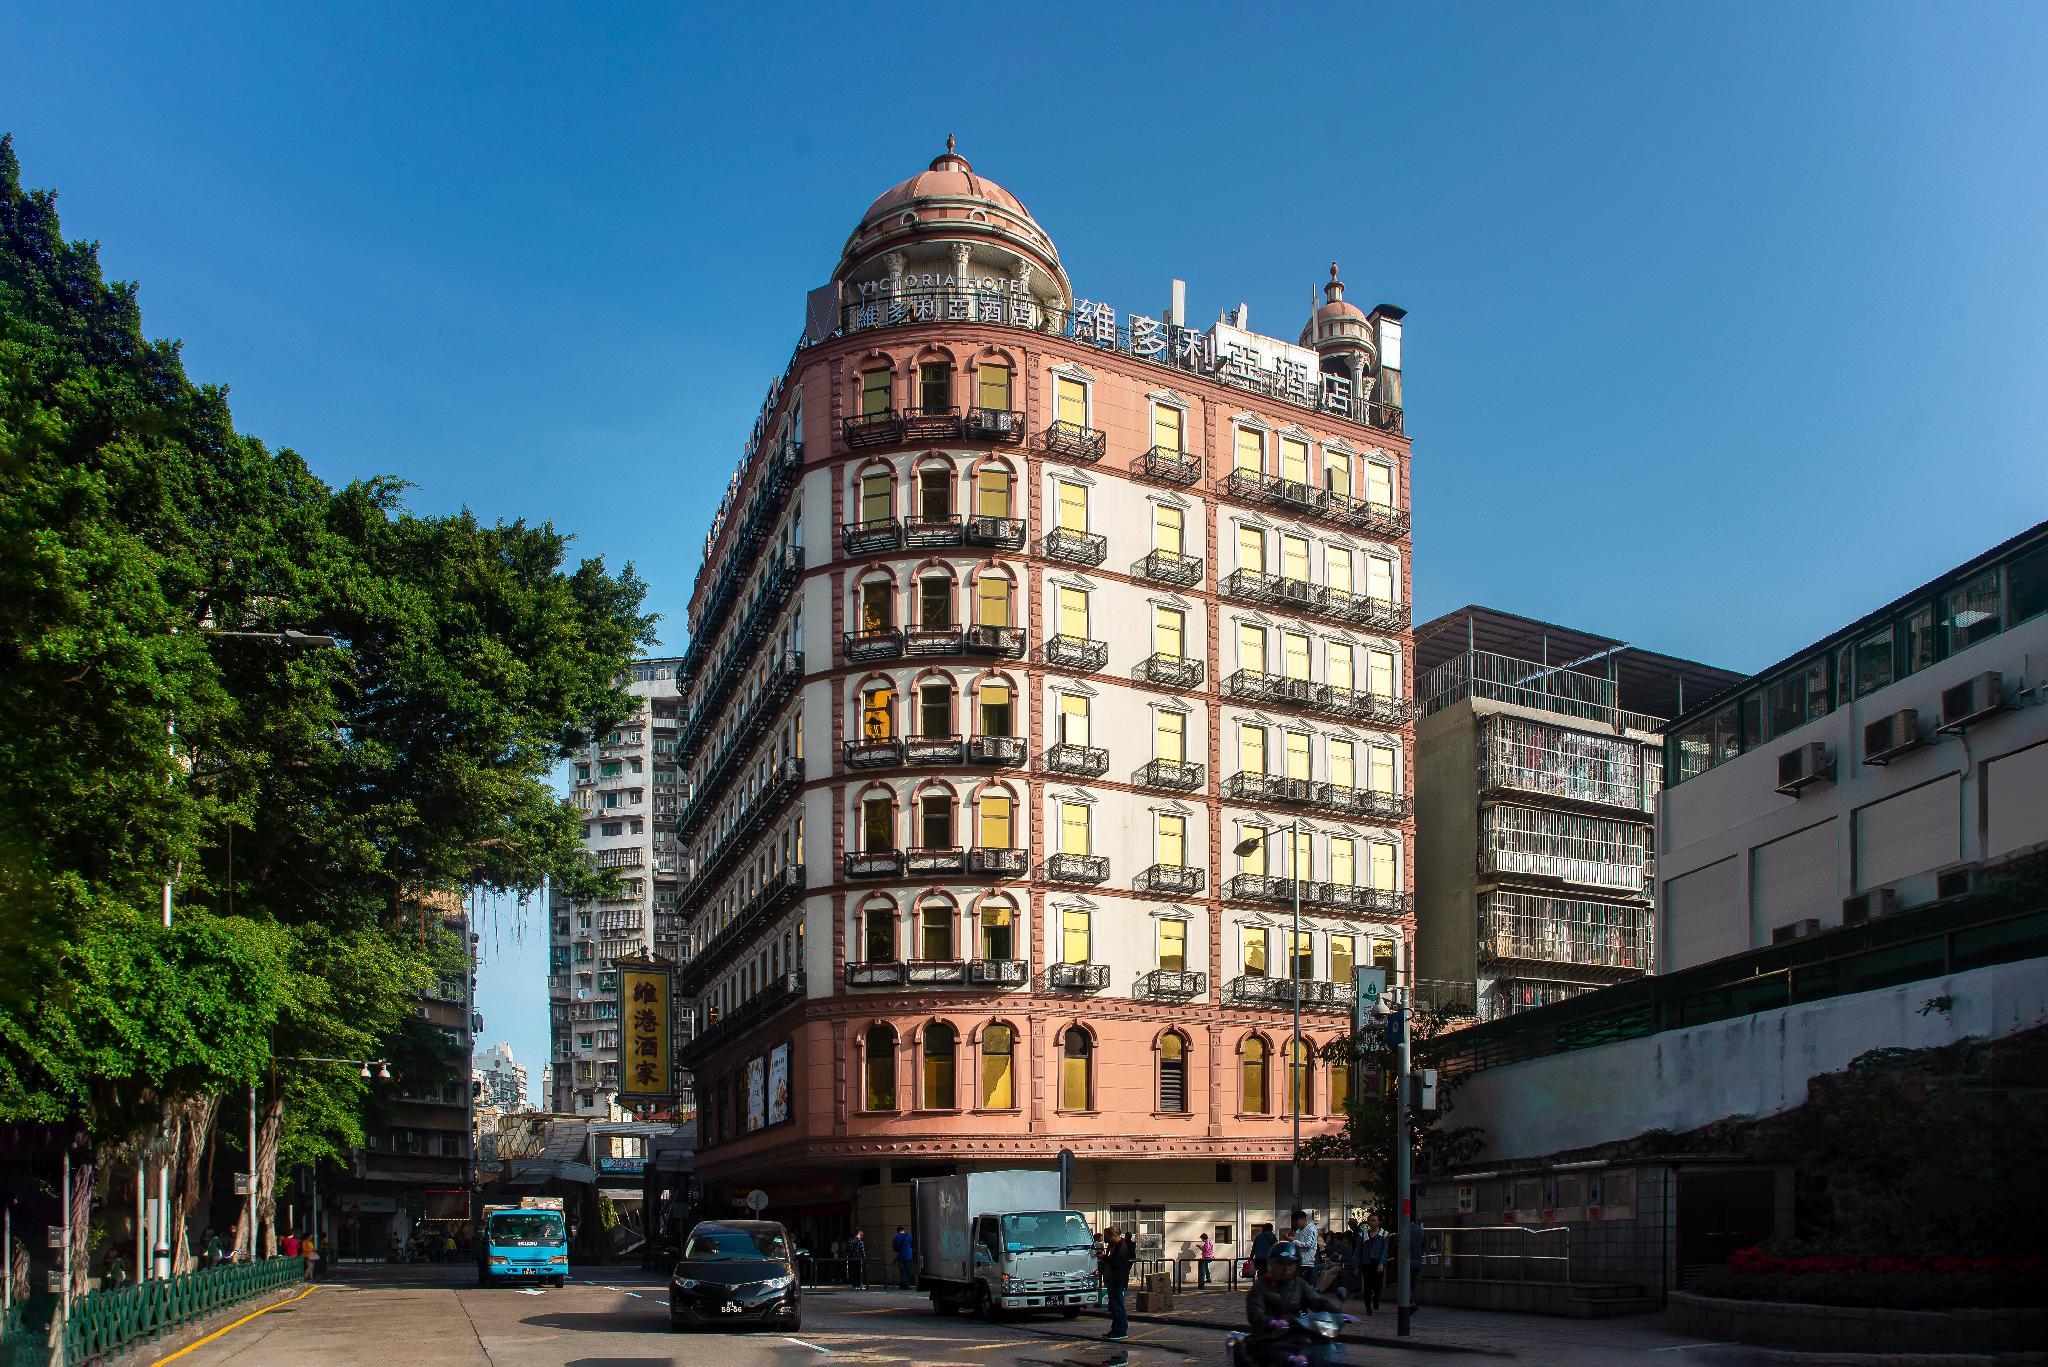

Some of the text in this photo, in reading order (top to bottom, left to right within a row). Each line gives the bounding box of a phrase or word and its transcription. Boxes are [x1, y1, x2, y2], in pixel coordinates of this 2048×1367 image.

[857, 273, 1031, 296] VICTORIA HOTEL
[857, 298, 1033, 328] 維多利亞酒店
[1075, 298, 1352, 415] 維多利亞酒店
[632, 980, 660, 1087] 維港酒家
